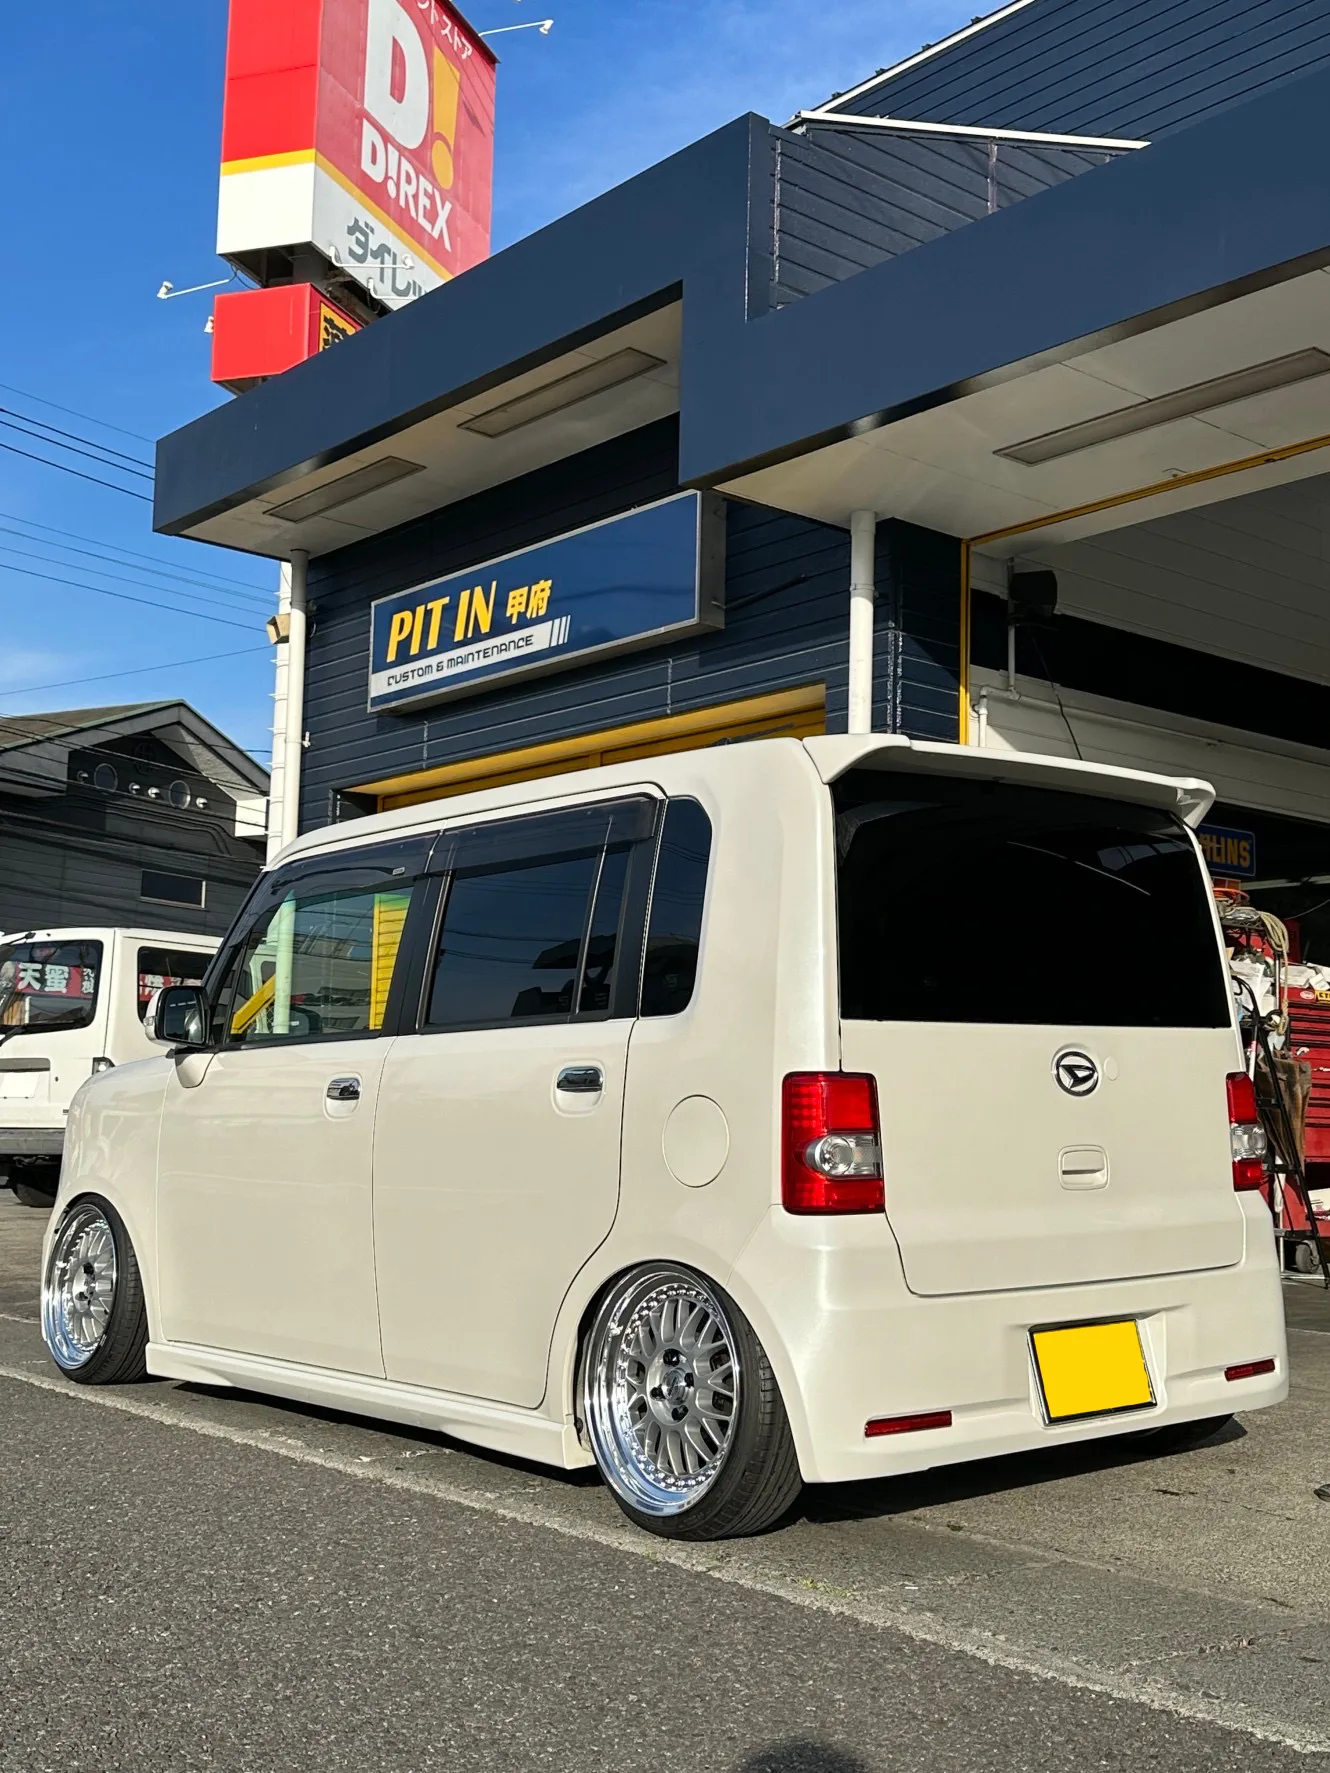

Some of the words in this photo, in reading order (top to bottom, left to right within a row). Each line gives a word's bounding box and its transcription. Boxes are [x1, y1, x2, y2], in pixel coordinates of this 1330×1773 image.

[386, 596, 450, 663] PIT
[454, 580, 498, 642] IN
[505, 579, 553, 624] 甲府
[387, 664, 433, 686] CUSTOM
[436, 660, 445, 673] &
[447, 634, 534, 670] MAINTENANCE
